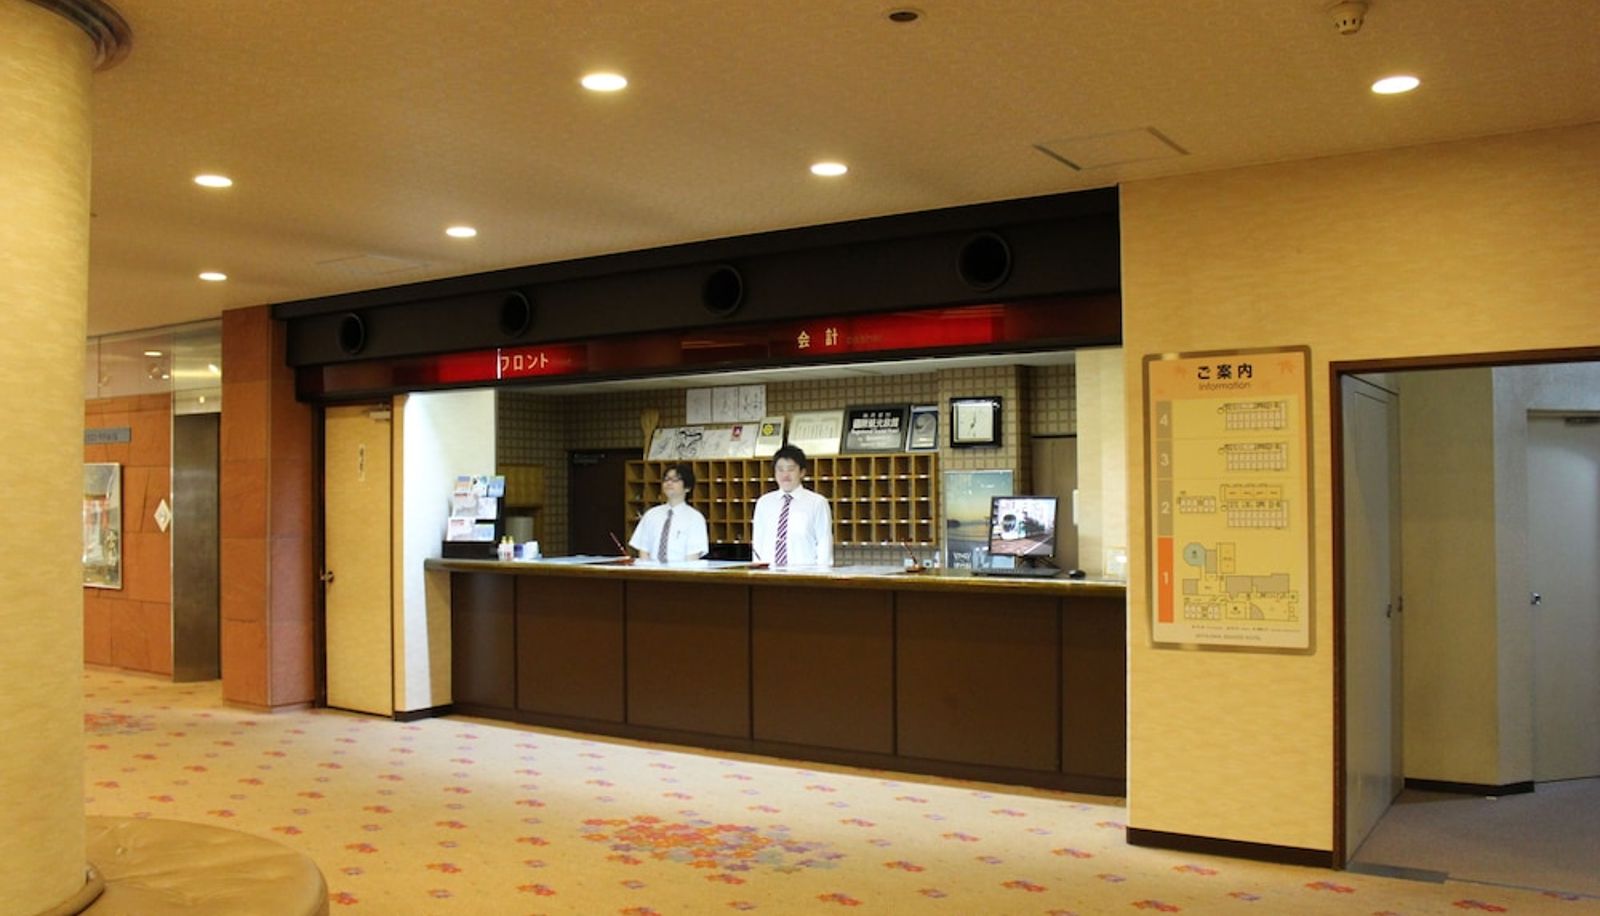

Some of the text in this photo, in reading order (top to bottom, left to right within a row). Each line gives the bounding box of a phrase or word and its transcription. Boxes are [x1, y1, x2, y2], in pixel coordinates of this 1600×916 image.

[797, 327, 838, 349] 会計
[501, 352, 549, 371] フロント
[1197, 363, 1252, 380] ご案内
[1159, 414, 1168, 426] 4
[1160, 453, 1169, 466] 3
[1161, 502, 1171, 514] 2
